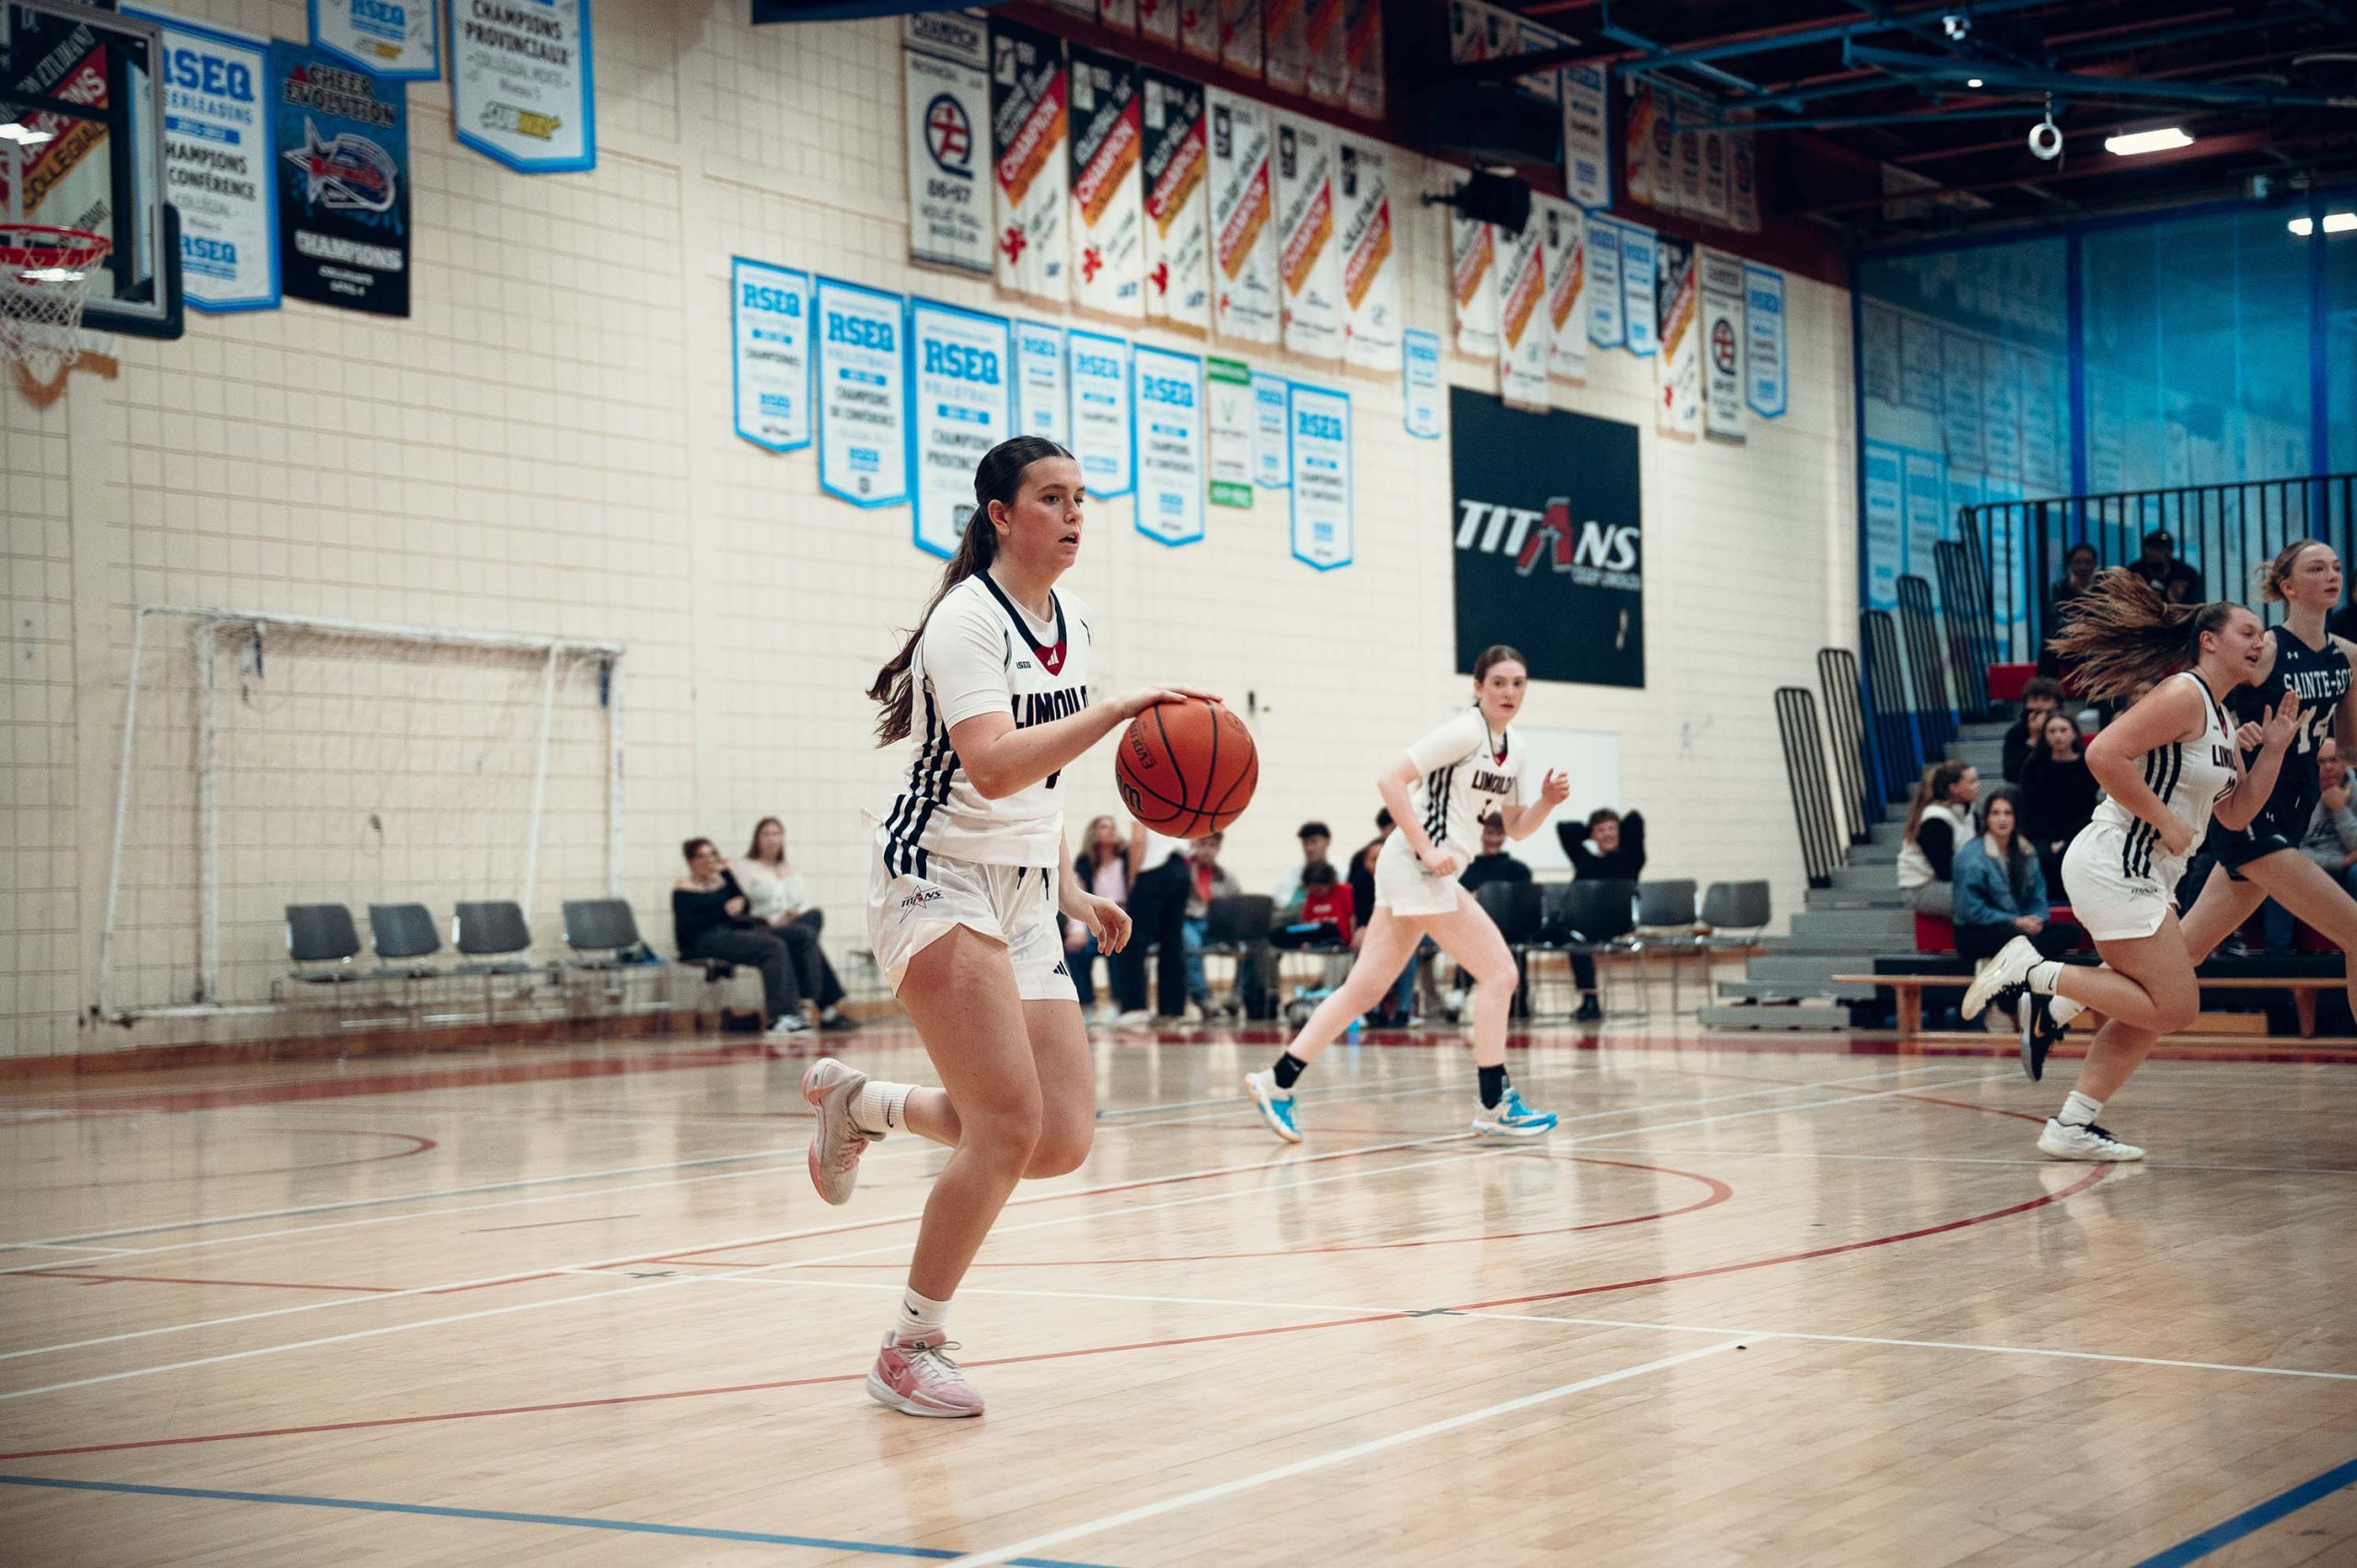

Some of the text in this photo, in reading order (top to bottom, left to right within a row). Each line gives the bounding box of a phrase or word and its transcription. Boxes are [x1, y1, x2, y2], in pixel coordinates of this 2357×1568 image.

[165, 141, 248, 175] HAMPIONS
[743, 282, 801, 317] RSEQ
[828, 311, 894, 352] RSEQ
[923, 338, 1000, 385] RSEQ
[1142, 374, 1193, 407] RSEQ
[1298, 411, 1343, 442] RSEQ
[1456, 496, 1642, 577] TITANS
